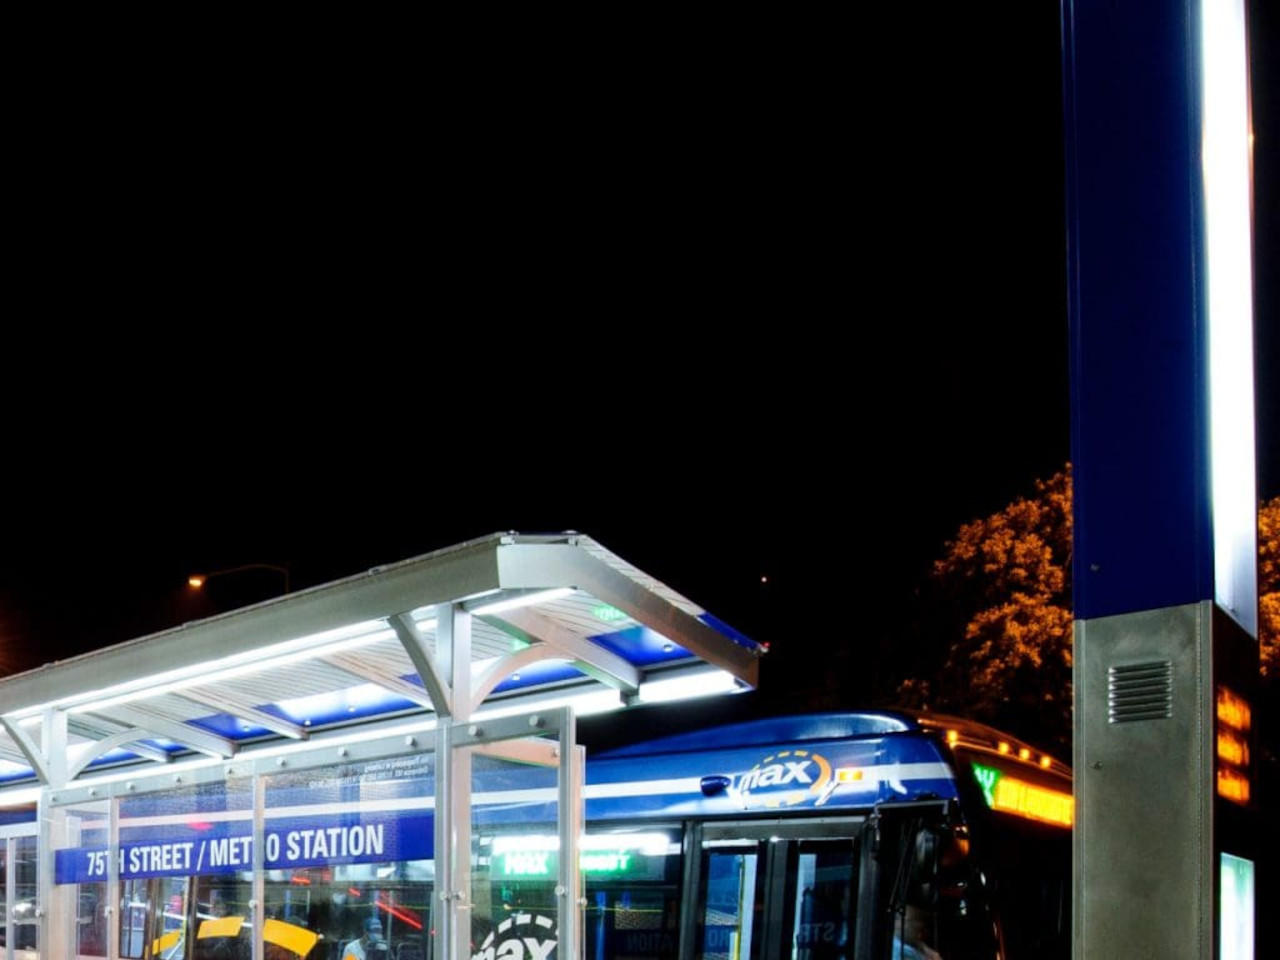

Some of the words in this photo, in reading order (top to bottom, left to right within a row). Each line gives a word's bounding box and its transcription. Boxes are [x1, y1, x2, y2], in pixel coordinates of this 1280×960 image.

[741, 761, 812, 790] max
[130, 843, 193, 873] STREET
[197, 841, 206, 872] /
[210, 833, 280, 866] METO
[286, 824, 385, 860] STATION
